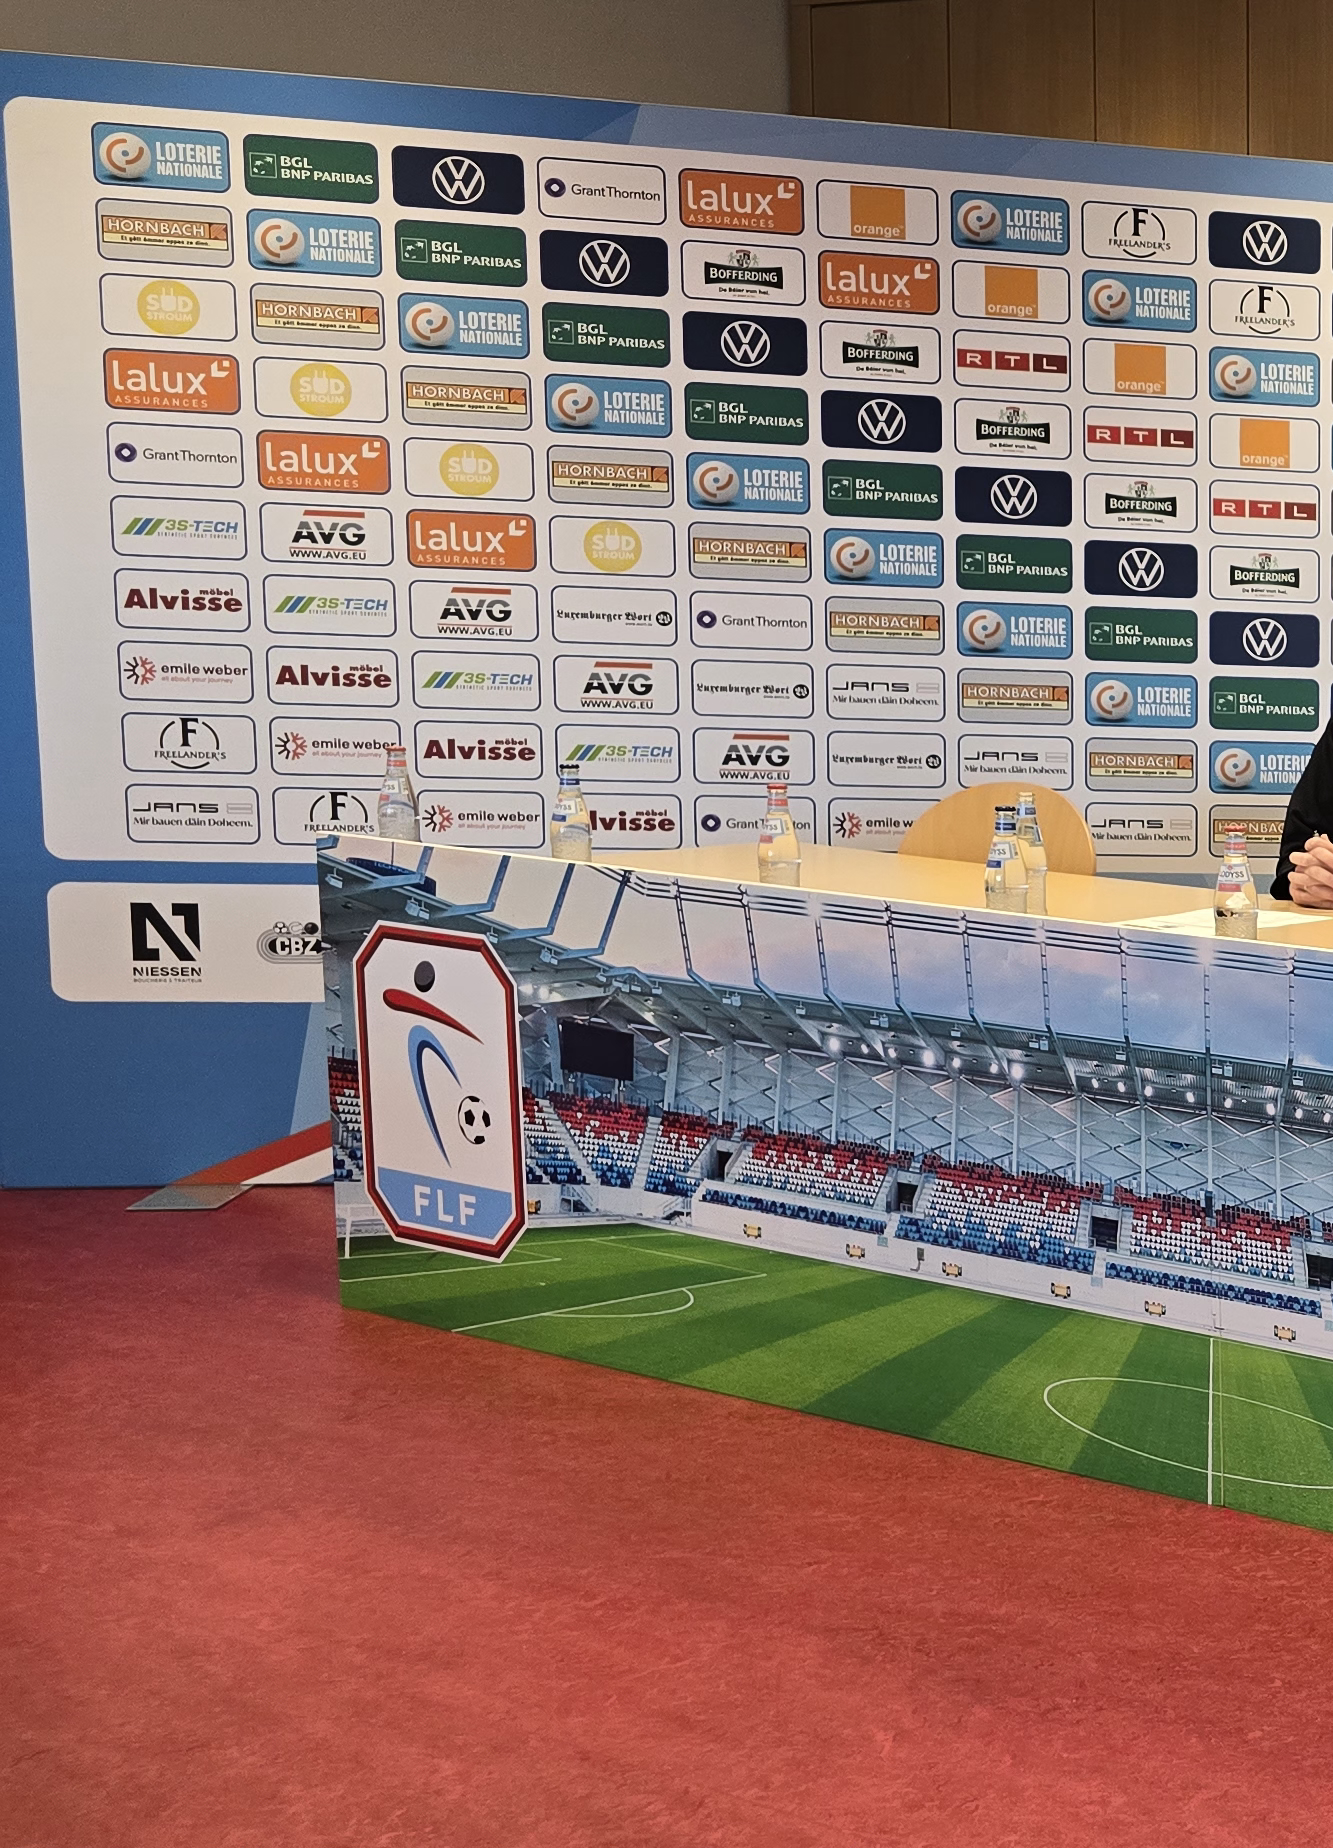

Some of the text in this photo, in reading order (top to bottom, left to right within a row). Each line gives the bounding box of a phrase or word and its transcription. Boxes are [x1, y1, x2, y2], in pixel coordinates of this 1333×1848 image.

[156, 142, 222, 164] LOTERIE
[280, 156, 312, 169] BGL
[157, 162, 222, 180] NATIONALE
[281, 168, 373, 185] BNP PARIBAS
[687, 180, 773, 215] lalux
[689, 215, 774, 228] ASSURANCES
[1006, 208, 1062, 230] LOTERIE
[108, 219, 205, 237] HORNBACH
[854, 225, 900, 237] orange
[1007, 226, 1063, 243] NATIONALE
[1108, 238, 1171, 252] FREELANDER'S
[710, 268, 778, 283] BOFFERDING
[147, 312, 192, 322] STROUM
[165, 519, 238, 533] 3S-TECH
[292, 521, 365, 546] AVG
[290, 549, 366, 560] WWW.AVG.EU
[200, 588, 234, 596] möbel
[124, 588, 242, 612] Alvisse
[836, 615, 920, 629] HORNBACH
[1115, 624, 1142, 635] BGL
[1116, 636, 1193, 647] BNP PARIBAS
[161, 664, 248, 676] emile weber
[154, 751, 226, 760] FREELANDER'S
[590, 811, 675, 832] lvisse
[276, 937, 318, 956] CBZ
[133, 967, 201, 976] NIESSEN
[414, 1184, 477, 1226] FLF
